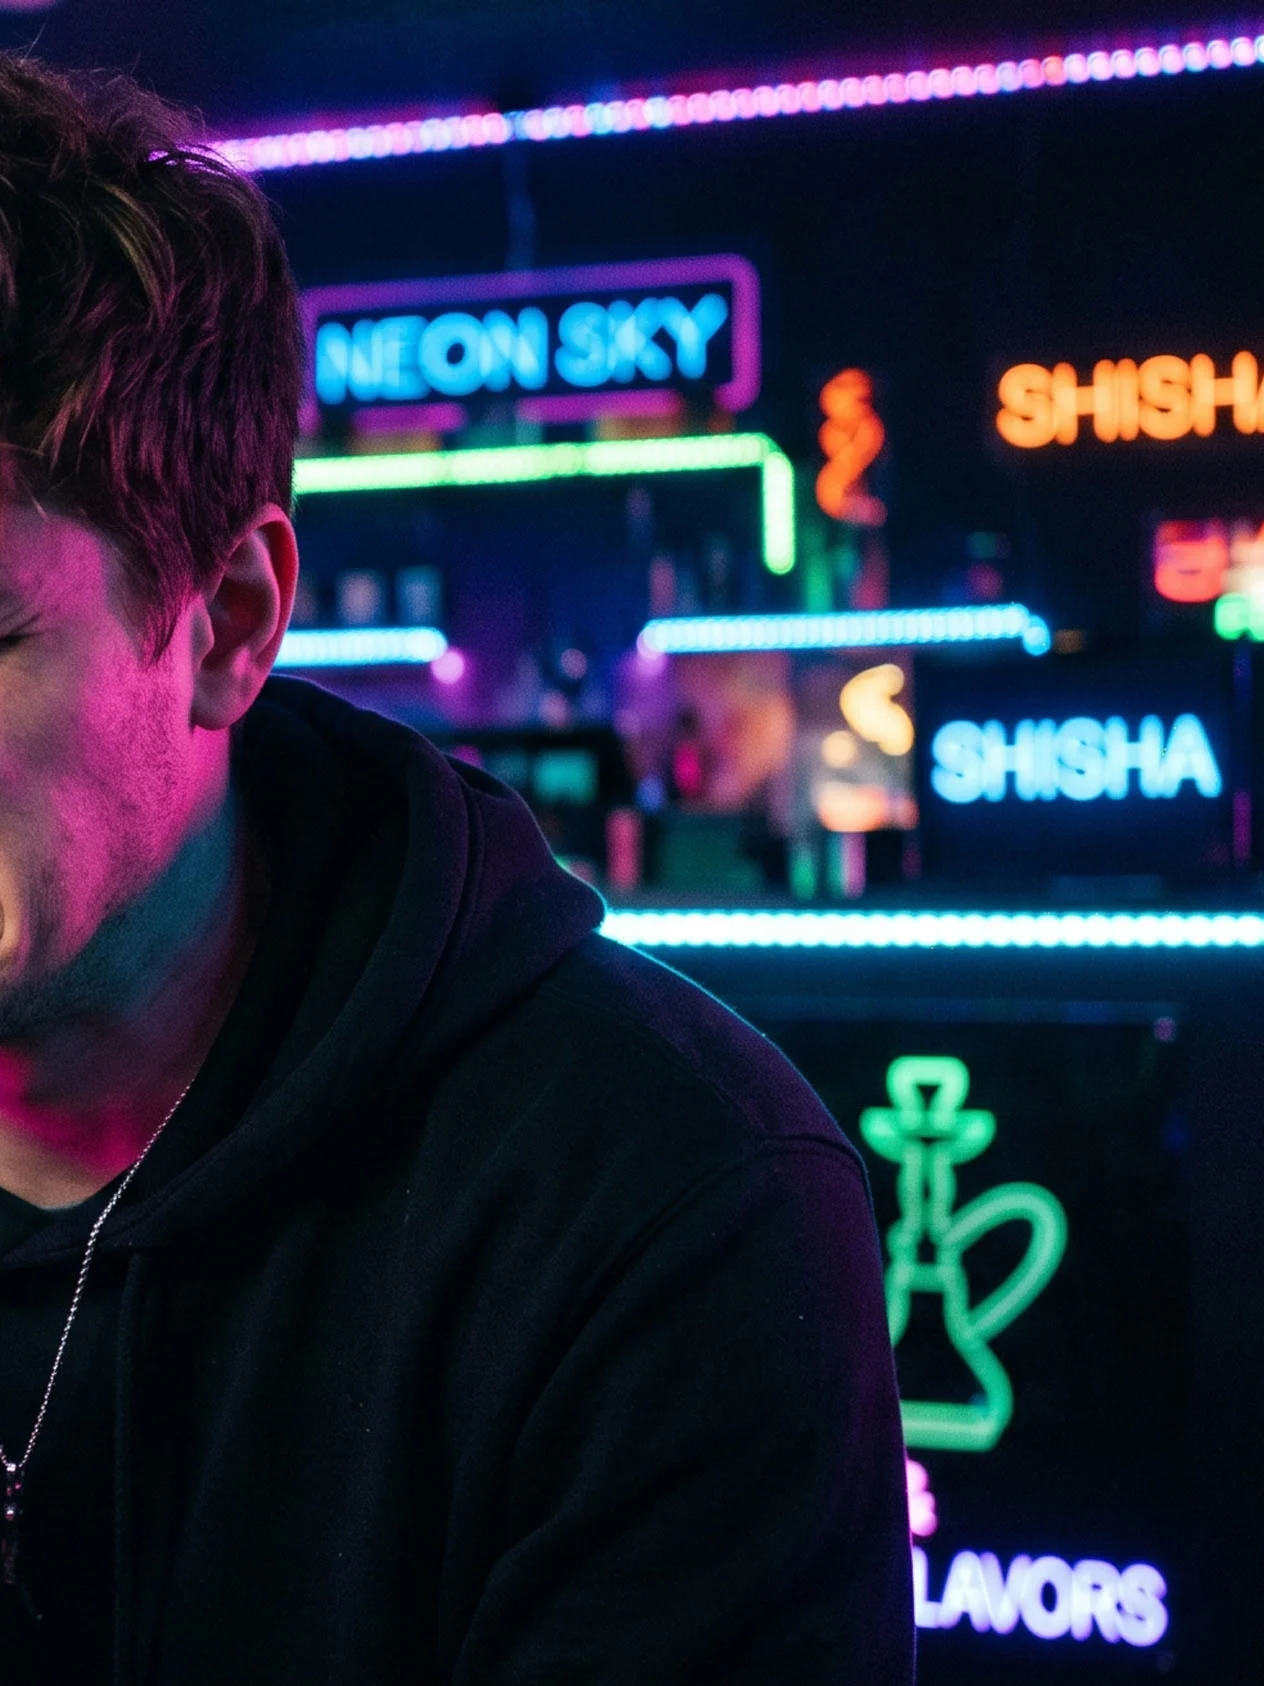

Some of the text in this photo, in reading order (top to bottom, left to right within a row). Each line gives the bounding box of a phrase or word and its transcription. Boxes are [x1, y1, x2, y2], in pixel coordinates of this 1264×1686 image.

[314, 293, 729, 404] NEON SKY
[995, 350, 1264, 449] SHISH
[930, 711, 1224, 806] SHISHA
